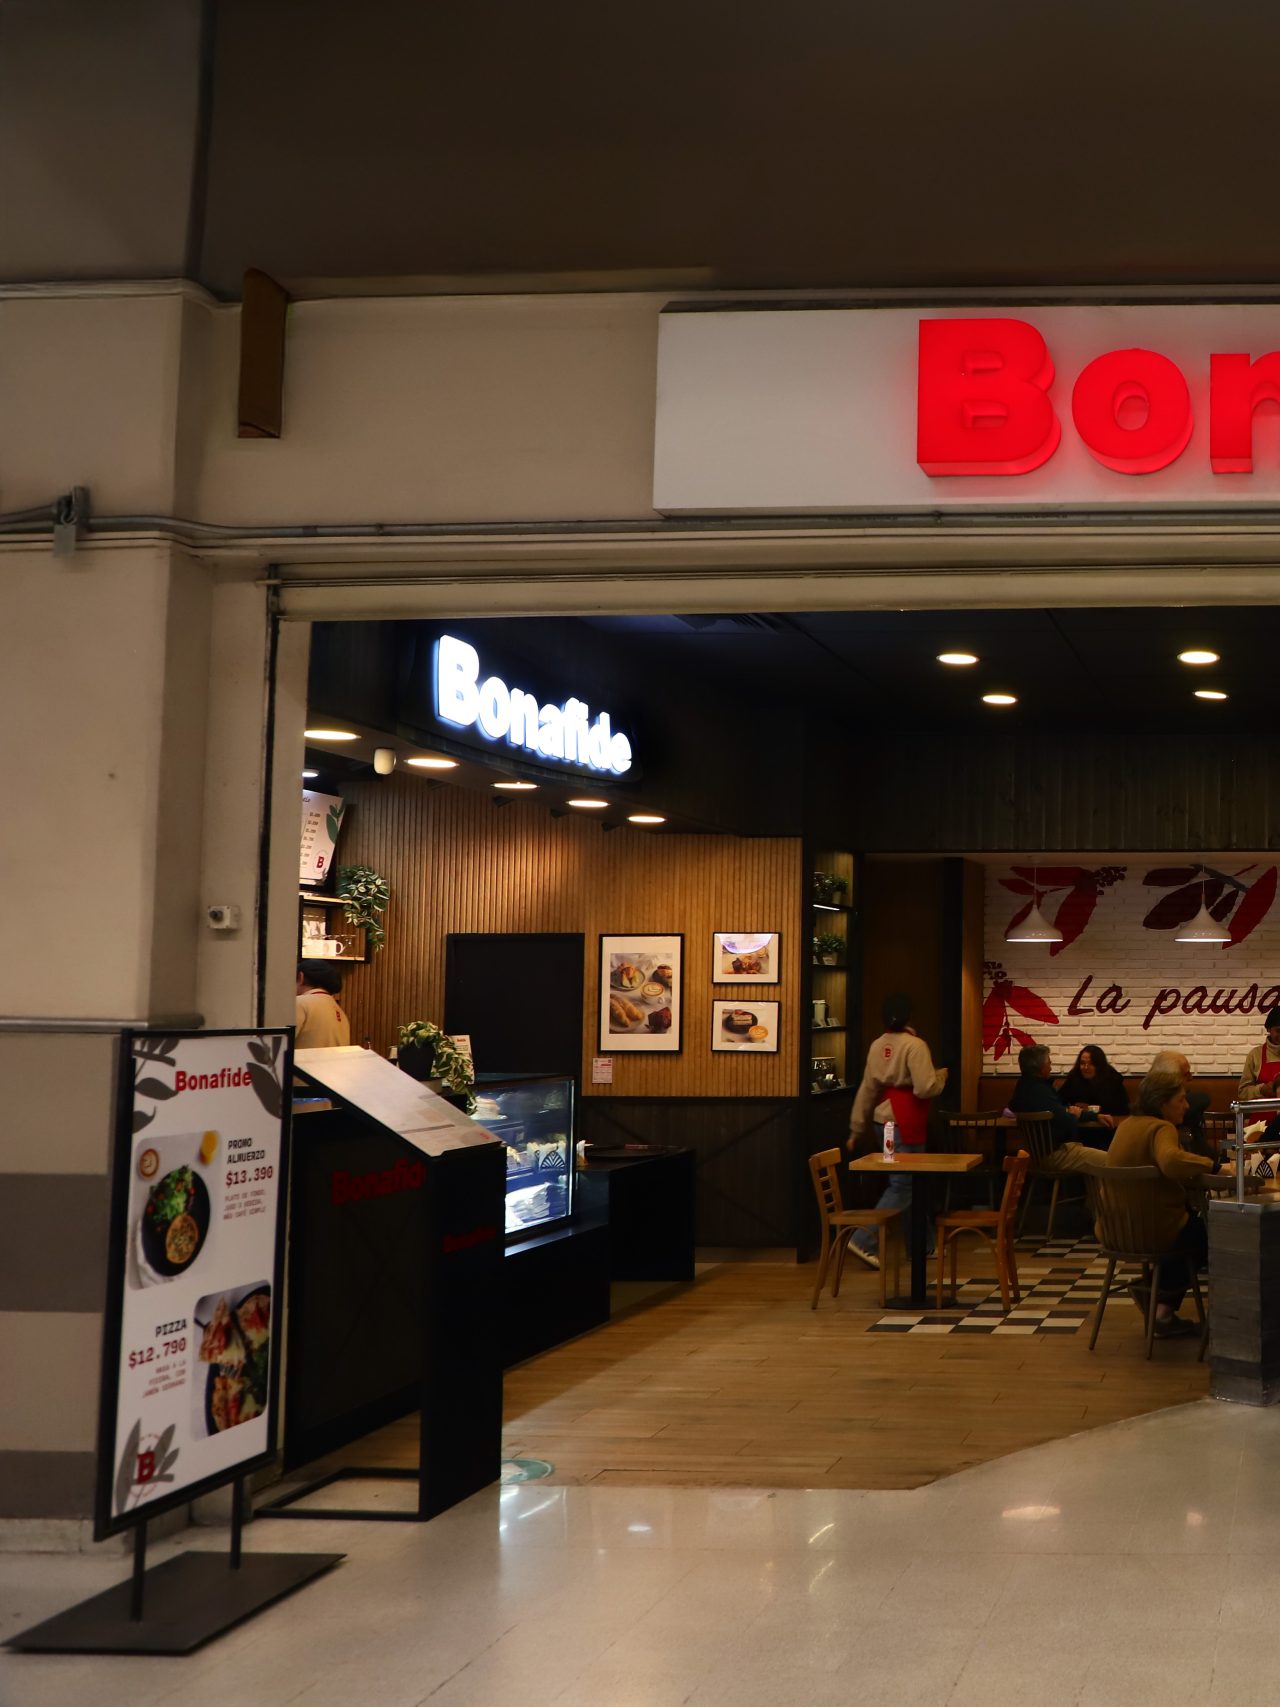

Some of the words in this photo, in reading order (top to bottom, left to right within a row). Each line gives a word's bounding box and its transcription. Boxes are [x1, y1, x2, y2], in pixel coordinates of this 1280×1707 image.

[437, 634, 632, 773] Bonafide
[1067, 975, 1131, 1015] La
[175, 1067, 252, 1092] Bonafide
[228, 1138, 253, 1150] PROMO
[227, 1150, 265, 1164] ALMUERZO
[225, 1165, 273, 1188] $13.390
[155, 1319, 187, 1338] PIZZA
[128, 1337, 187, 1369] $12.790
